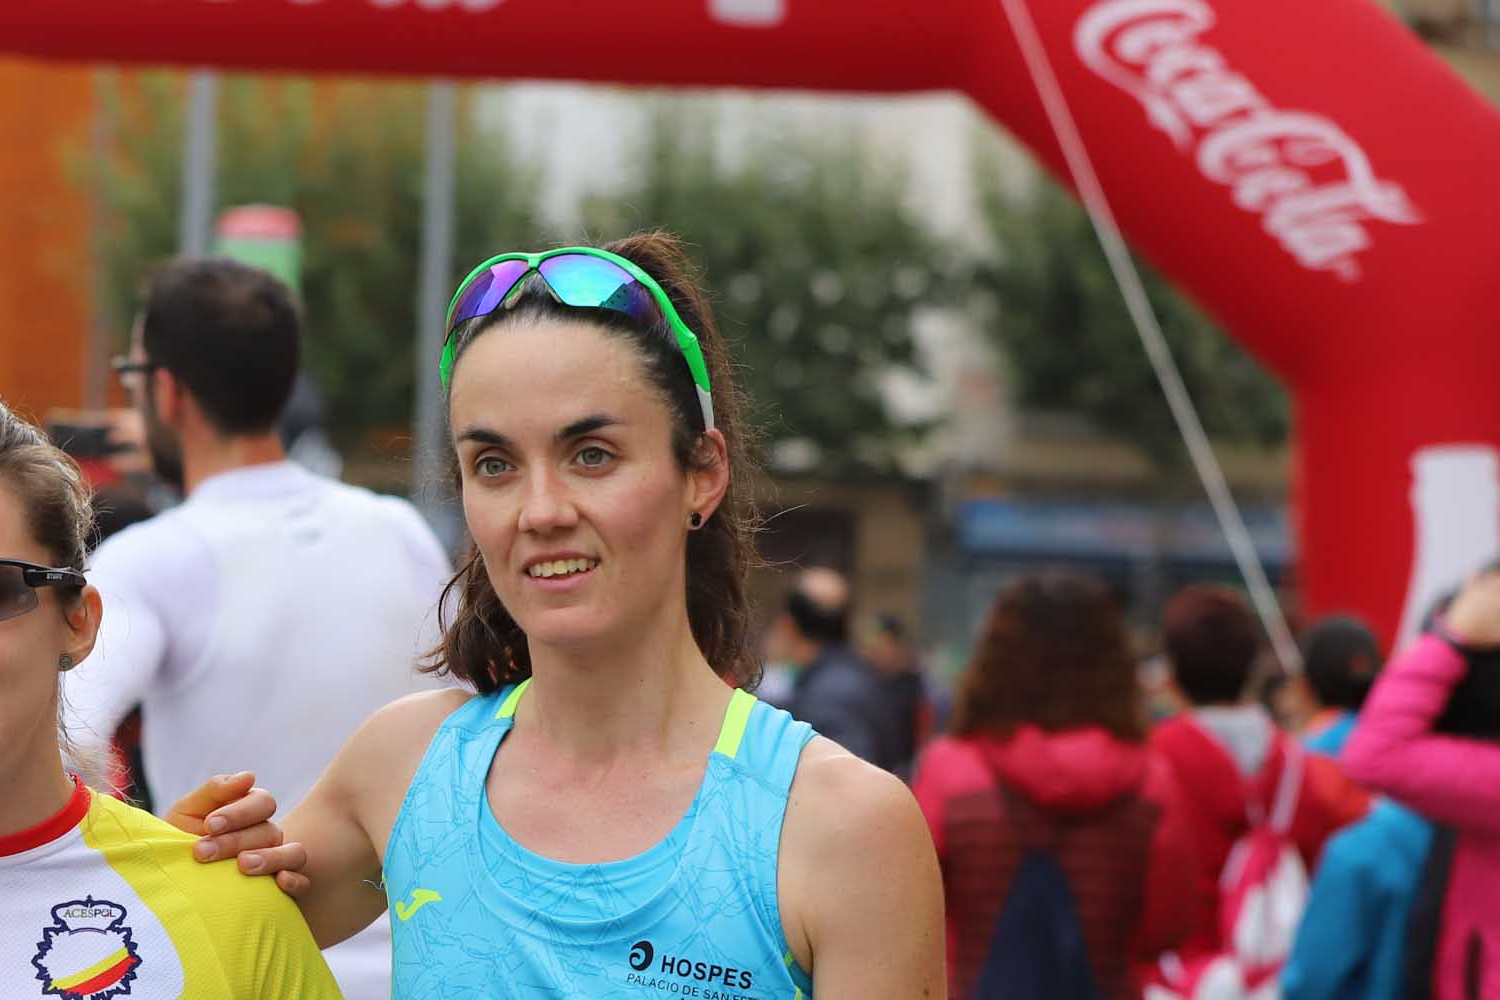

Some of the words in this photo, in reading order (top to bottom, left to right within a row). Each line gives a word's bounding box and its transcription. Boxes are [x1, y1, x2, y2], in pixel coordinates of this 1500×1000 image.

[63, 908, 117, 919] ACESPOL
[661, 955, 753, 990] HOSPES
[626, 973, 679, 993] PALACIO
[682, 984, 699, 997] DE
